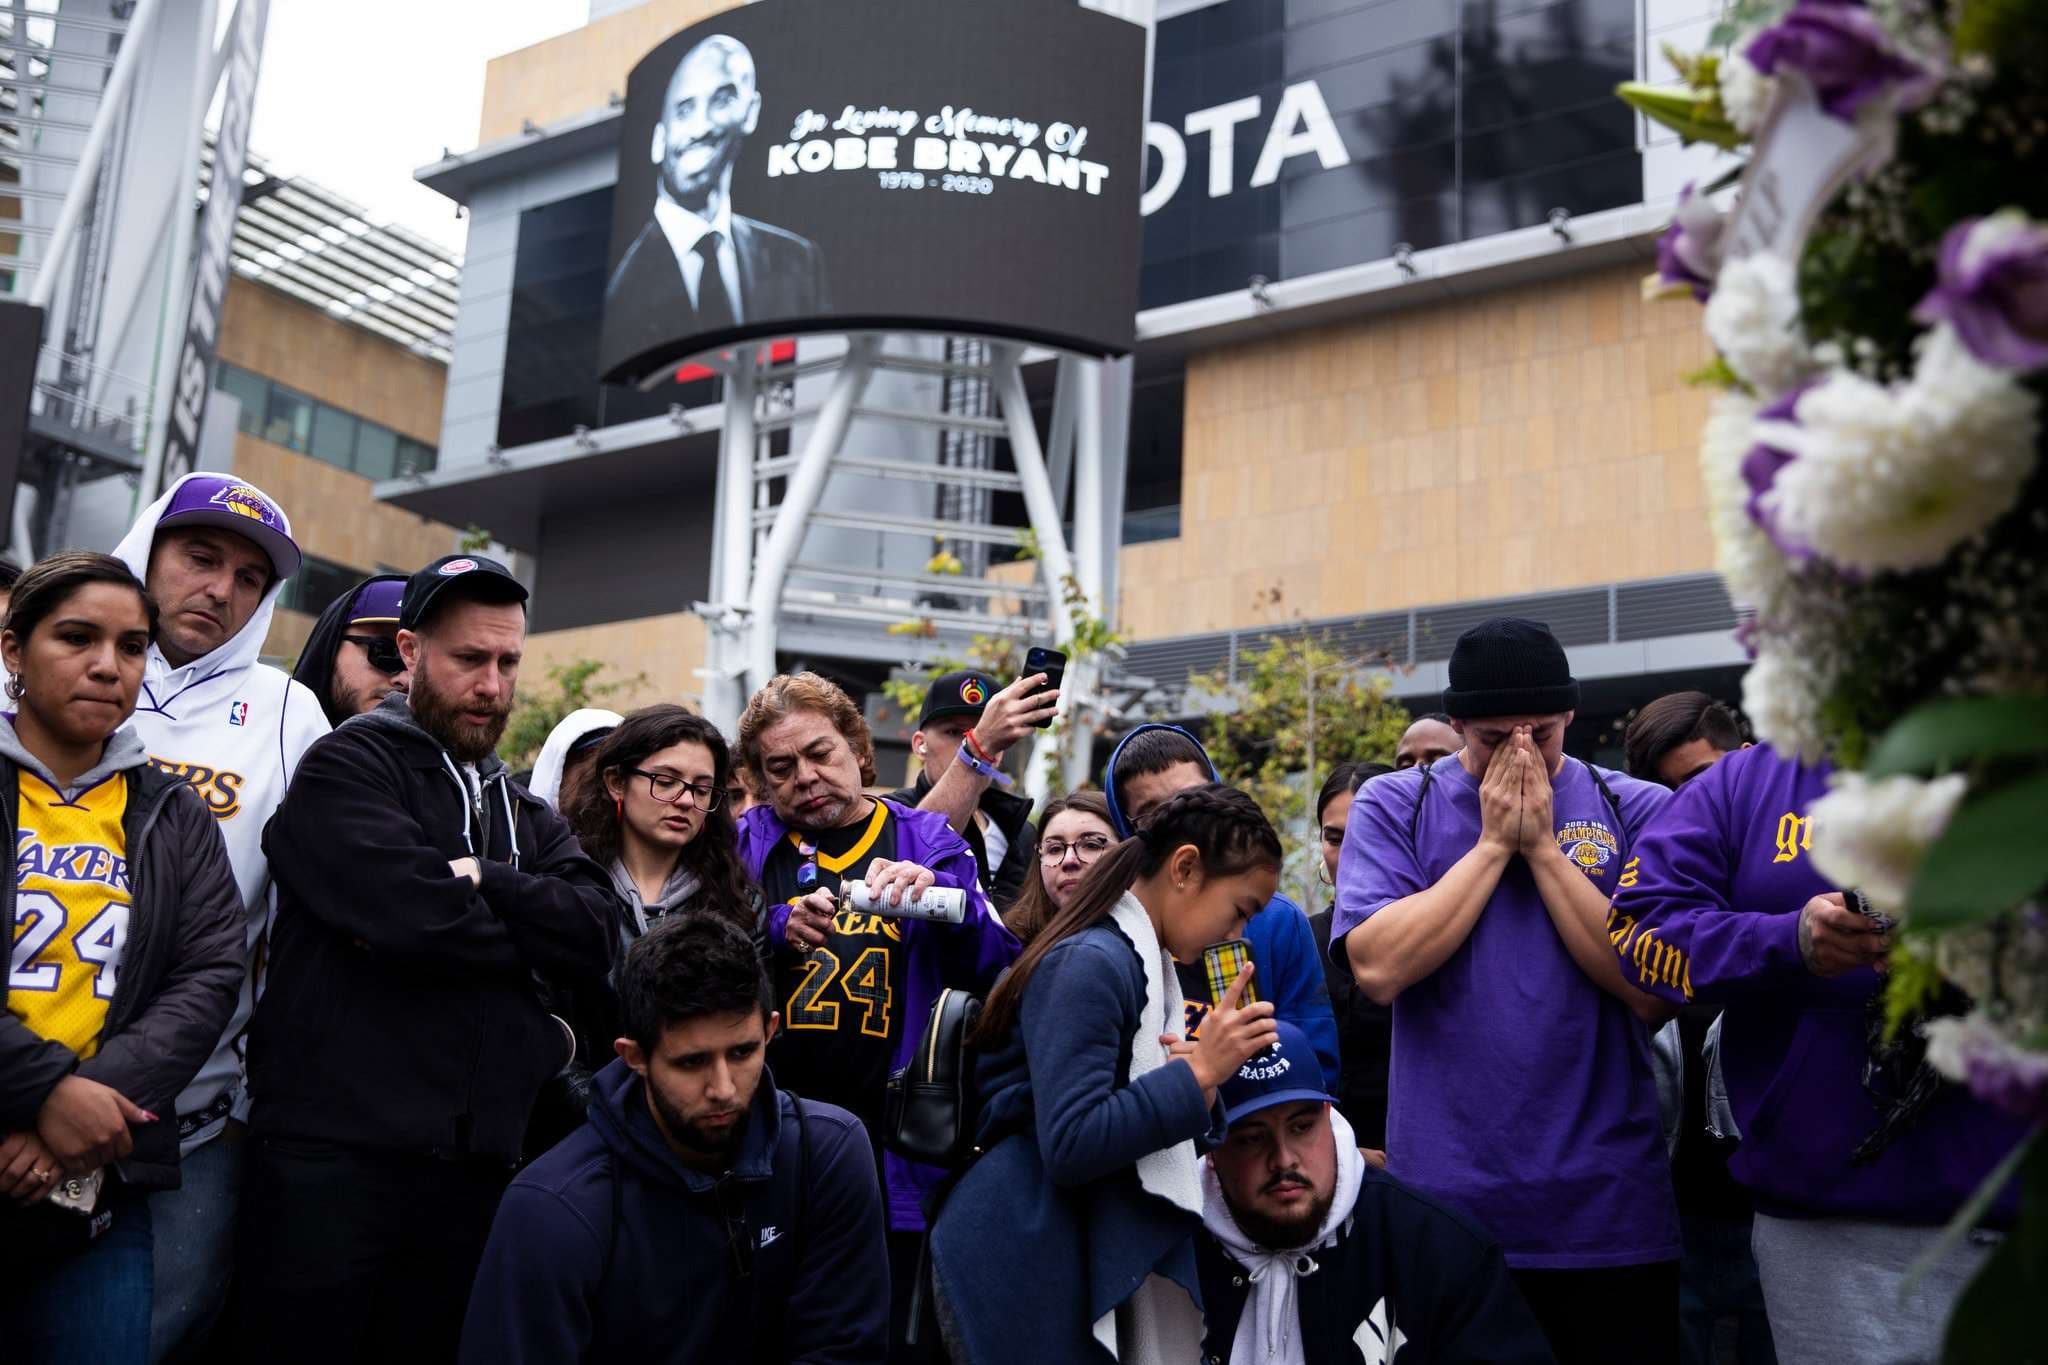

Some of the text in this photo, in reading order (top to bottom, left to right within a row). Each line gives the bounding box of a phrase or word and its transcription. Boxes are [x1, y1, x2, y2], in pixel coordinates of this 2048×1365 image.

[832, 105, 920, 136] Loving
[924, 105, 1041, 146] Memory
[1045, 122, 1088, 156] Of
[767, 136, 1110, 196] KOBE BRYANT
[942, 174, 994, 195] 2020
[1556, 826, 1618, 855] CHAMPIONS
[9, 889, 131, 1000] 24
[786, 947, 892, 1039] 24
